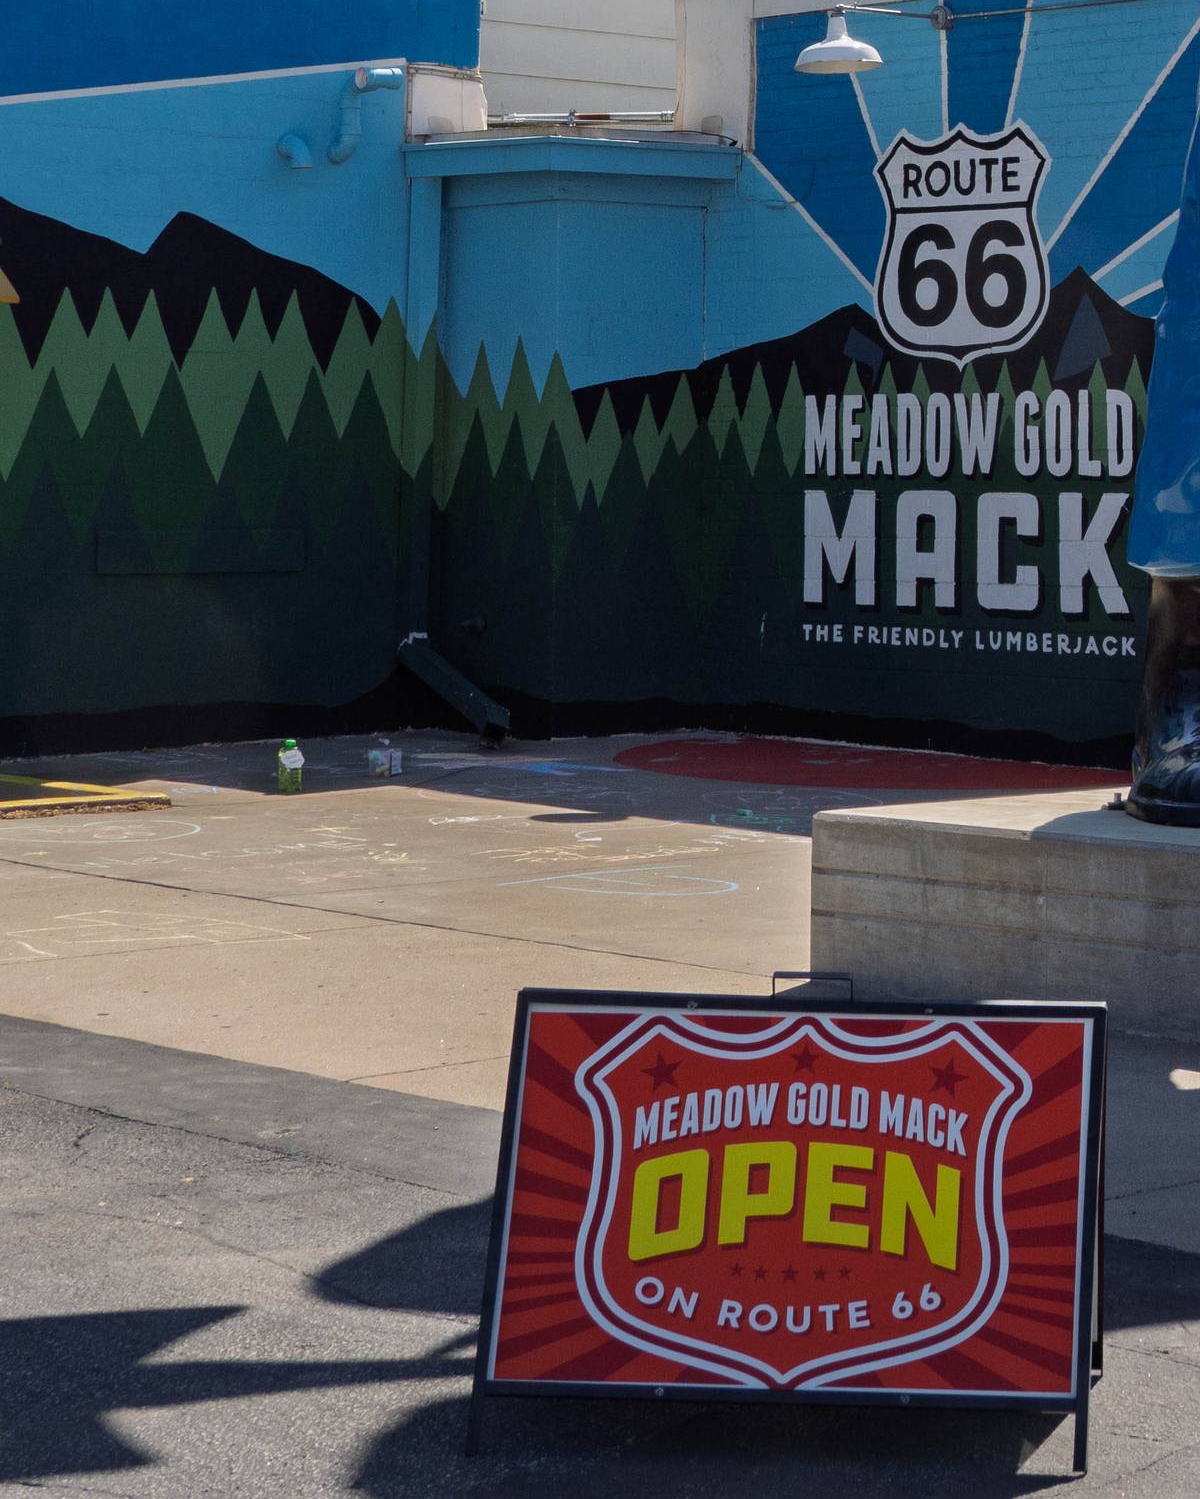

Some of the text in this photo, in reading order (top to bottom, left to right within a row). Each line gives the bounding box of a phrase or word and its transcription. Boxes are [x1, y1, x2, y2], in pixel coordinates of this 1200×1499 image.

[902, 156, 1021, 199] ROUTE
[898, 219, 1028, 329] 66
[804, 389, 1135, 478] MEADOW GOLD
[803, 490, 1130, 614] MACK
[803, 624, 1136, 656] THE FRIENDLY LUMBERJACK
[633, 1082, 969, 1156] MEADOW GOLD MACK
[627, 1140, 962, 1271] OPEN
[634, 1276, 942, 1334] ON ROUTE 66
